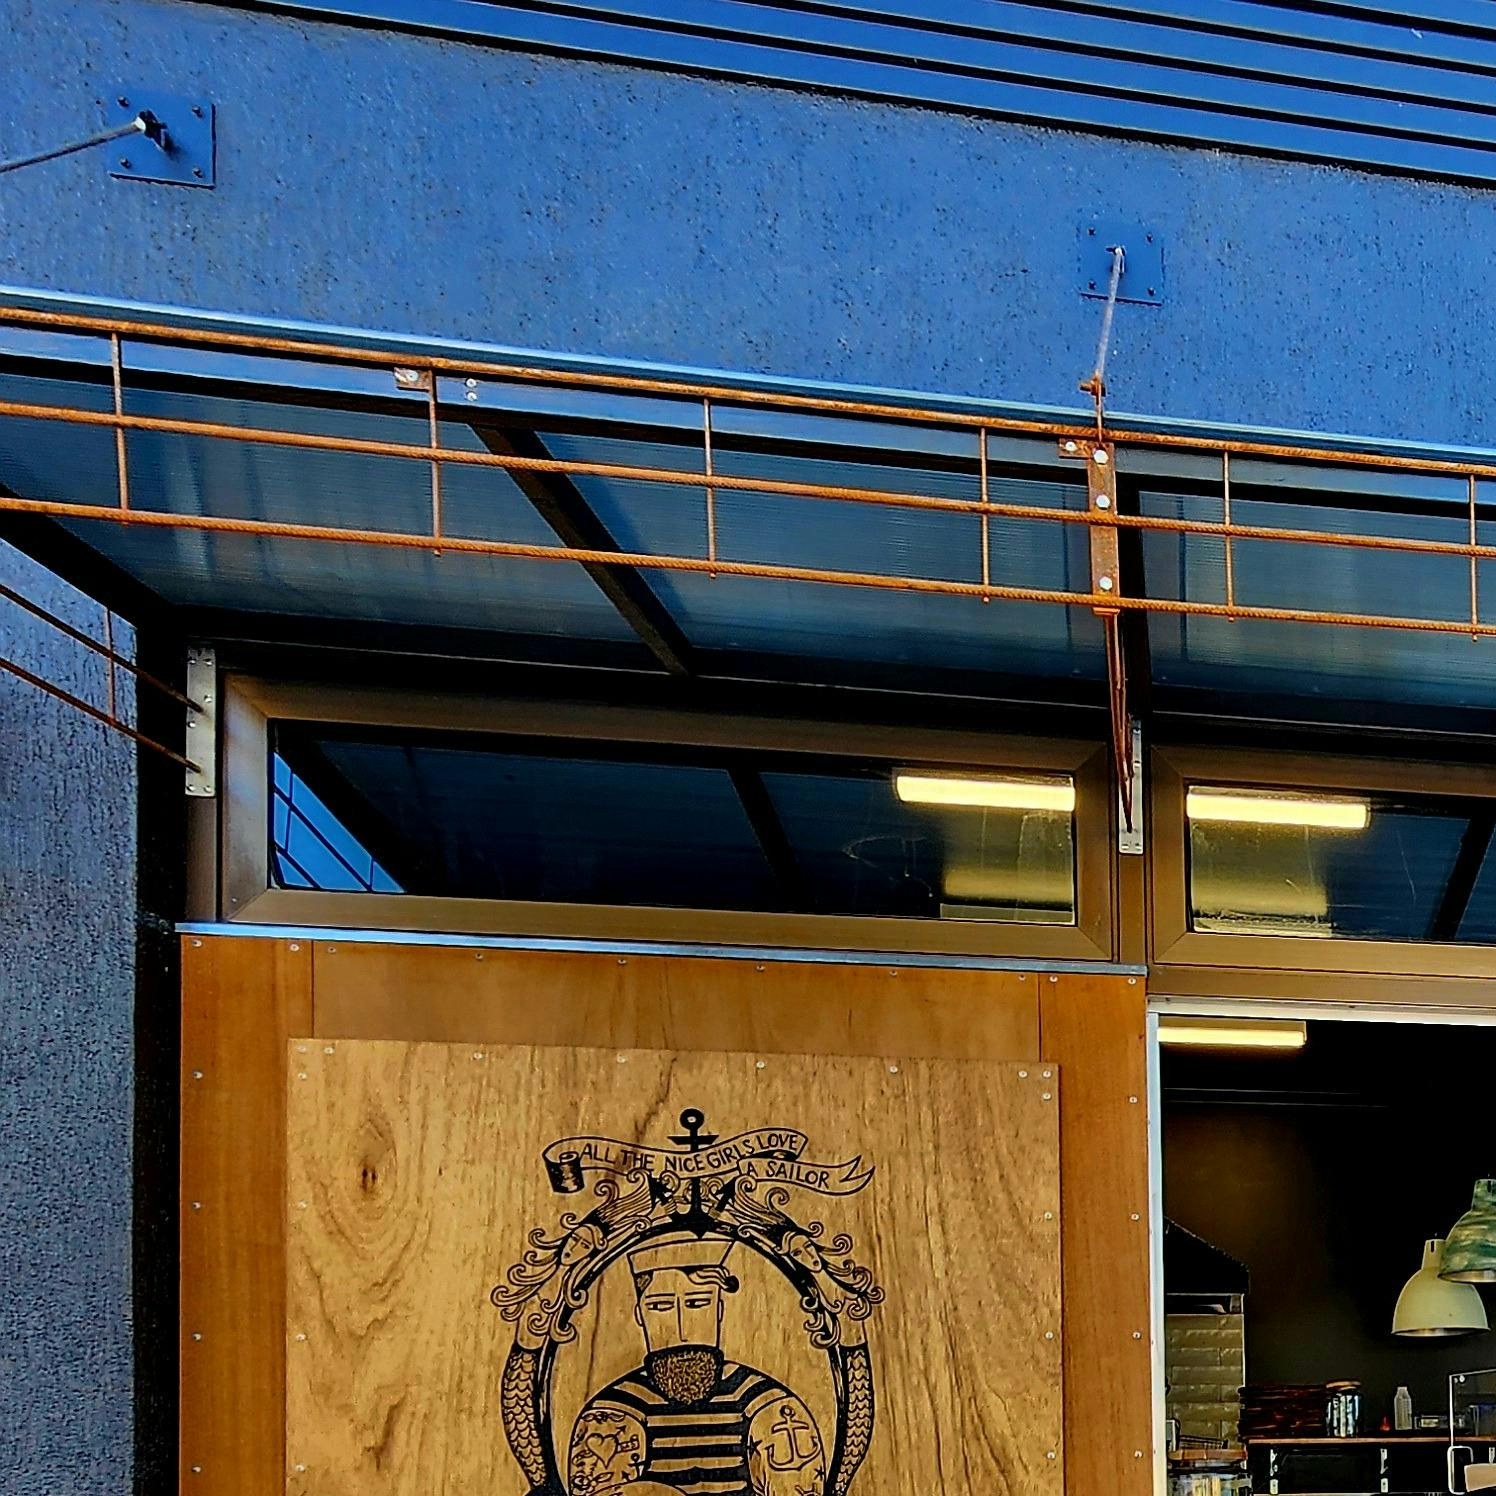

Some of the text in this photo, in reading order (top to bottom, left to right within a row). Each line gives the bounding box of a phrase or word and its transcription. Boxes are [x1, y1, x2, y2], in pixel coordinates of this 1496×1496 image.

[580, 1132, 799, 1173] ALL THE NICE GIRLS LOVE
[747, 1161, 829, 1189] A SAILOR
